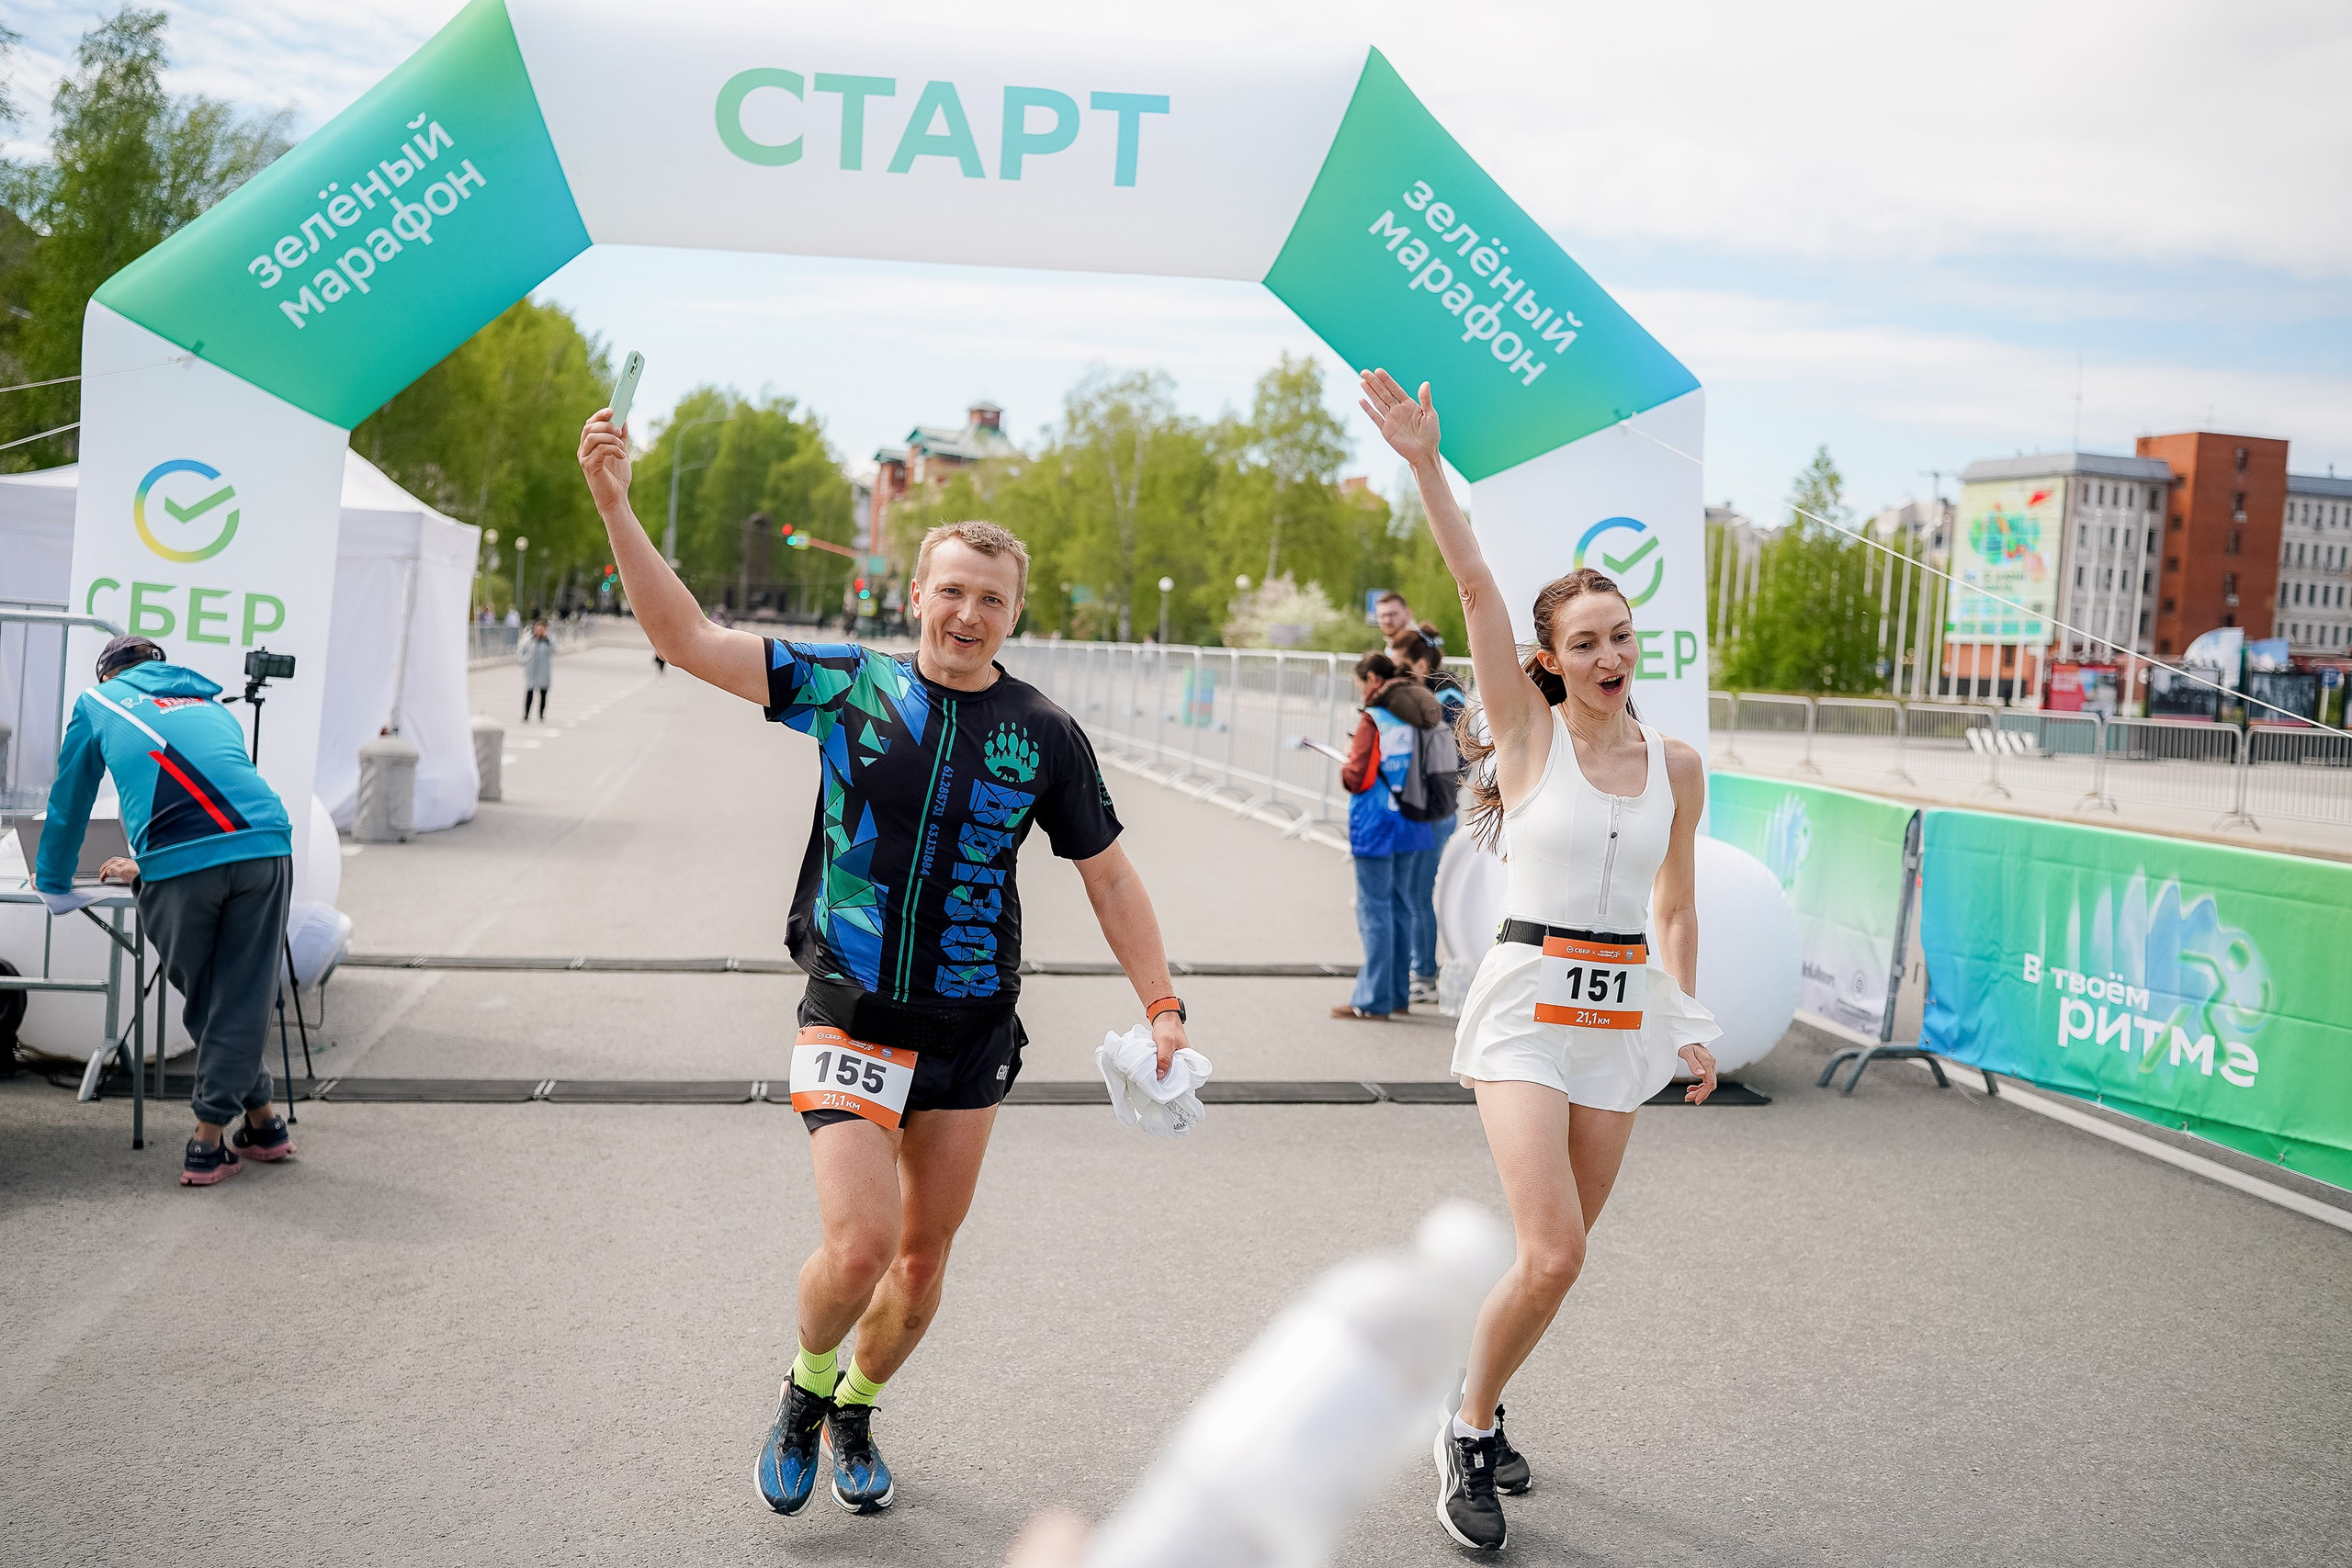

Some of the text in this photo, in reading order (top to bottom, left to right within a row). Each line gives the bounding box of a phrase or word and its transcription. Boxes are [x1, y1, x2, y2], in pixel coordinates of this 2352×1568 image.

[715, 66, 1170, 188] СТАРТ
[247, 111, 455, 289] зелёный
[278, 158, 487, 331] марафон
[1367, 209, 1548, 388] марафон
[1402, 179, 1585, 355] зелёный
[85, 577, 286, 648] СБЕР
[932, 765, 955, 817] 61.285731
[1566, 966, 1627, 1004] 151
[2050, 965, 2150, 1012] твоём
[814, 1051, 888, 1094] 155
[2057, 995, 2260, 1088] ритме
